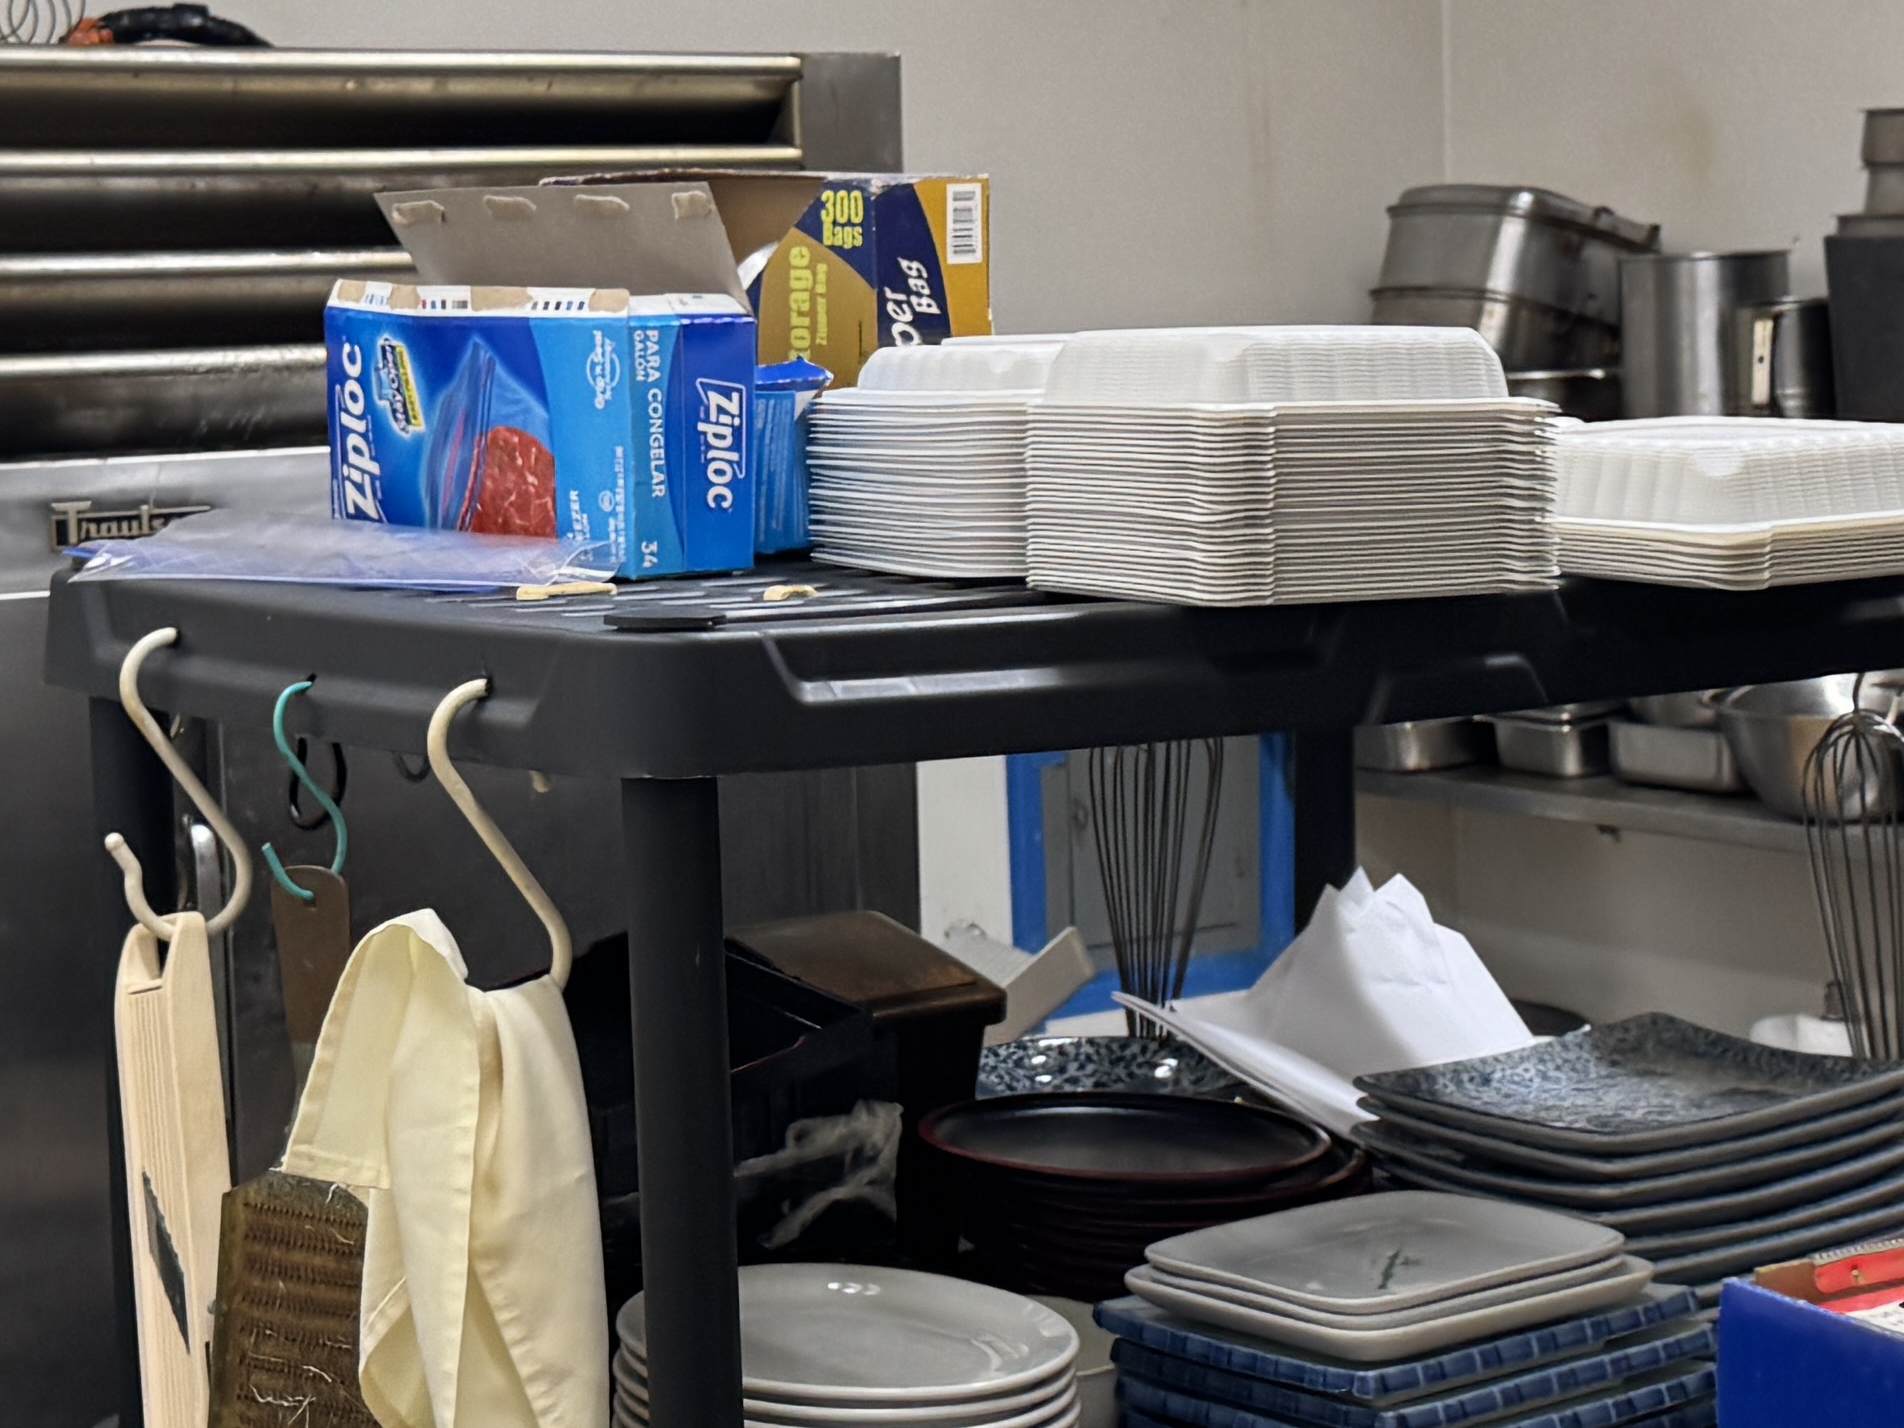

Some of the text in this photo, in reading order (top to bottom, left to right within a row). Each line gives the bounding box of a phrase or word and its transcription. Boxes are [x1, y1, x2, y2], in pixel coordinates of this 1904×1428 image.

[820, 189, 864, 224] 300
[822, 222, 864, 248] Bags
[789, 246, 813, 360] torage
[897, 257, 942, 315] Bag
[883, 287, 923, 347] per
[340, 342, 381, 520] Ziploc
[643, 330, 667, 498] PARA CONGELAR
[697, 390, 740, 509] Ziploc
[641, 541, 658, 568] 34
